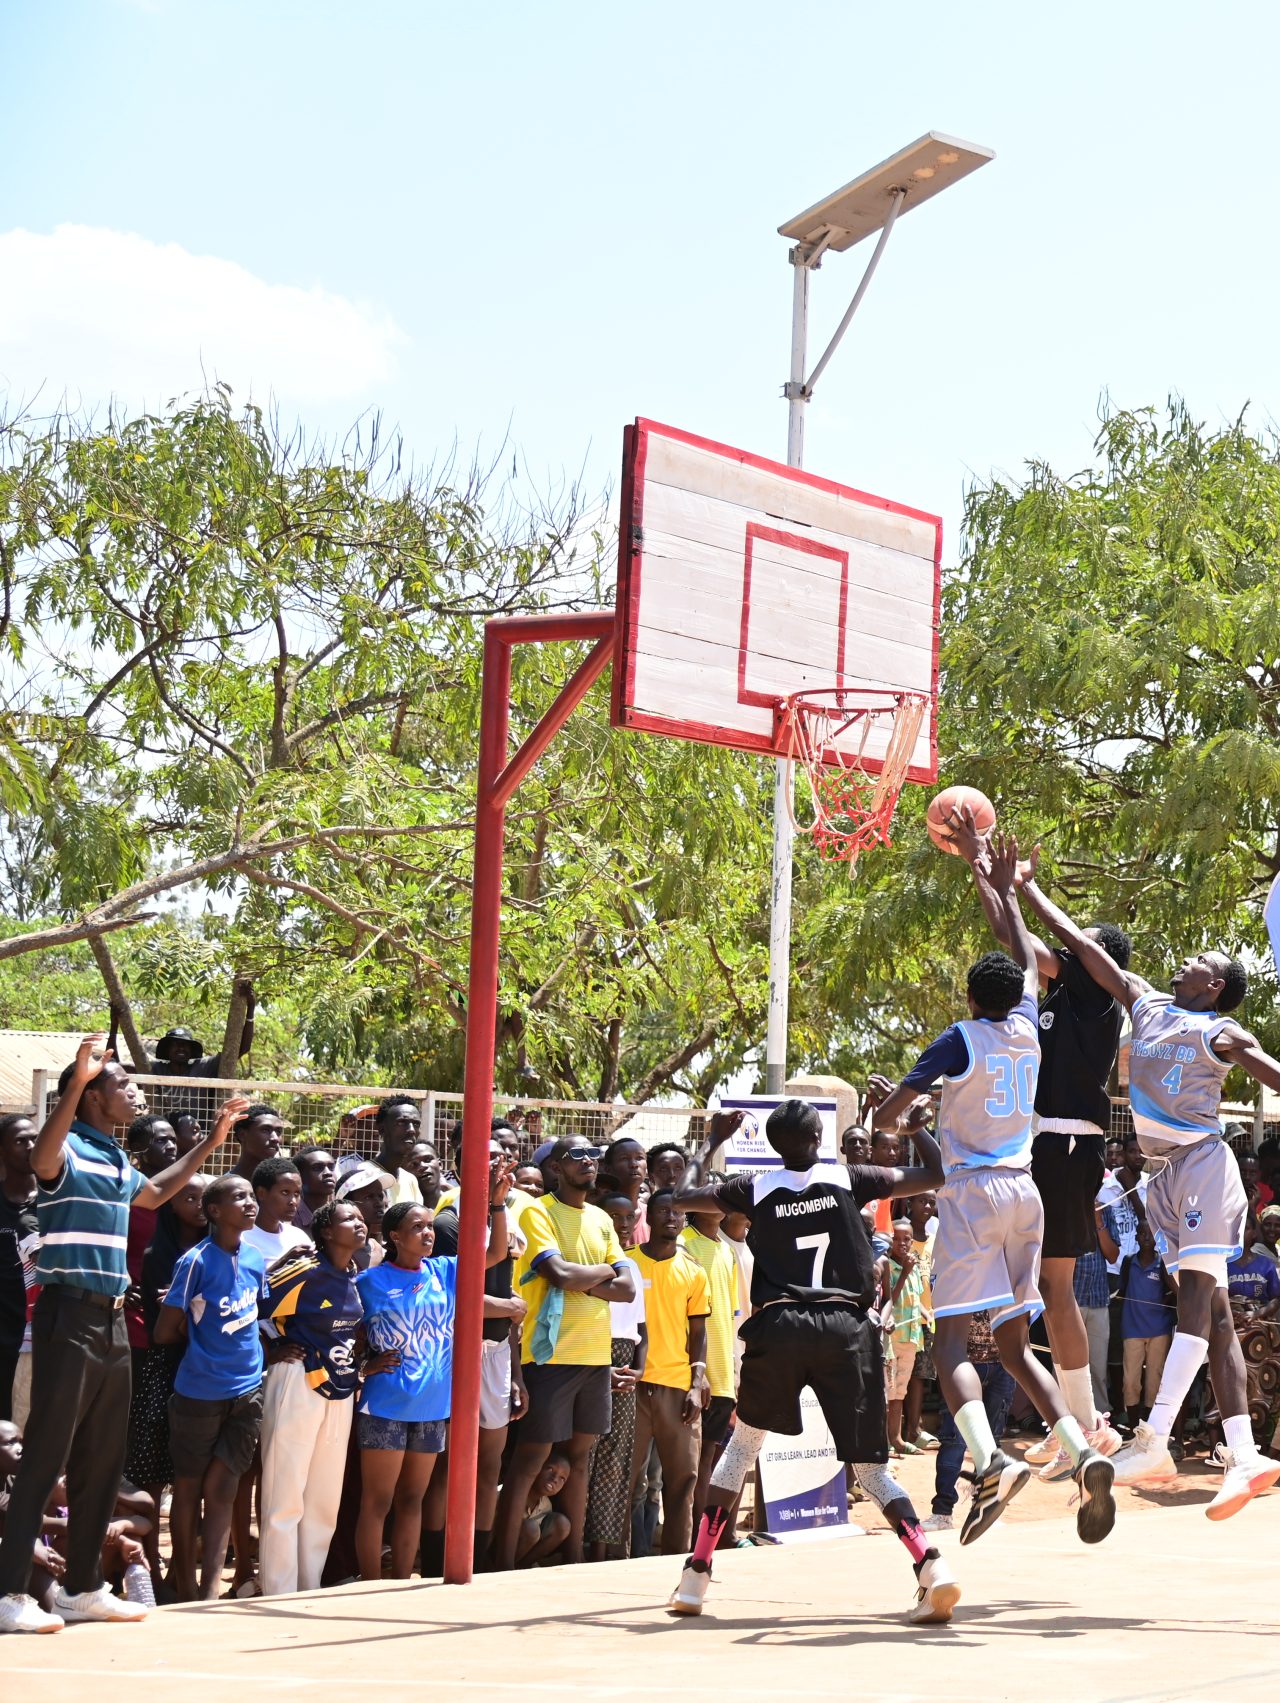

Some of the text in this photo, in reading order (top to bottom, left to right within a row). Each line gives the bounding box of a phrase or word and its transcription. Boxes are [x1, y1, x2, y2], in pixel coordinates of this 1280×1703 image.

[1175, 1045, 1197, 1064] BB
[985, 1053, 1038, 1117] 30
[1161, 1064, 1183, 1094] 4
[775, 1194, 838, 1219] MUGOMBWA
[796, 1231, 830, 1290] 7
[801, 1398, 820, 1408] Educa
[766, 1452, 774, 1462] LET
[775, 1452, 787, 1461] GIRLS
[804, 1449, 817, 1459] LEAD
[818, 1448, 828, 1457] AND
